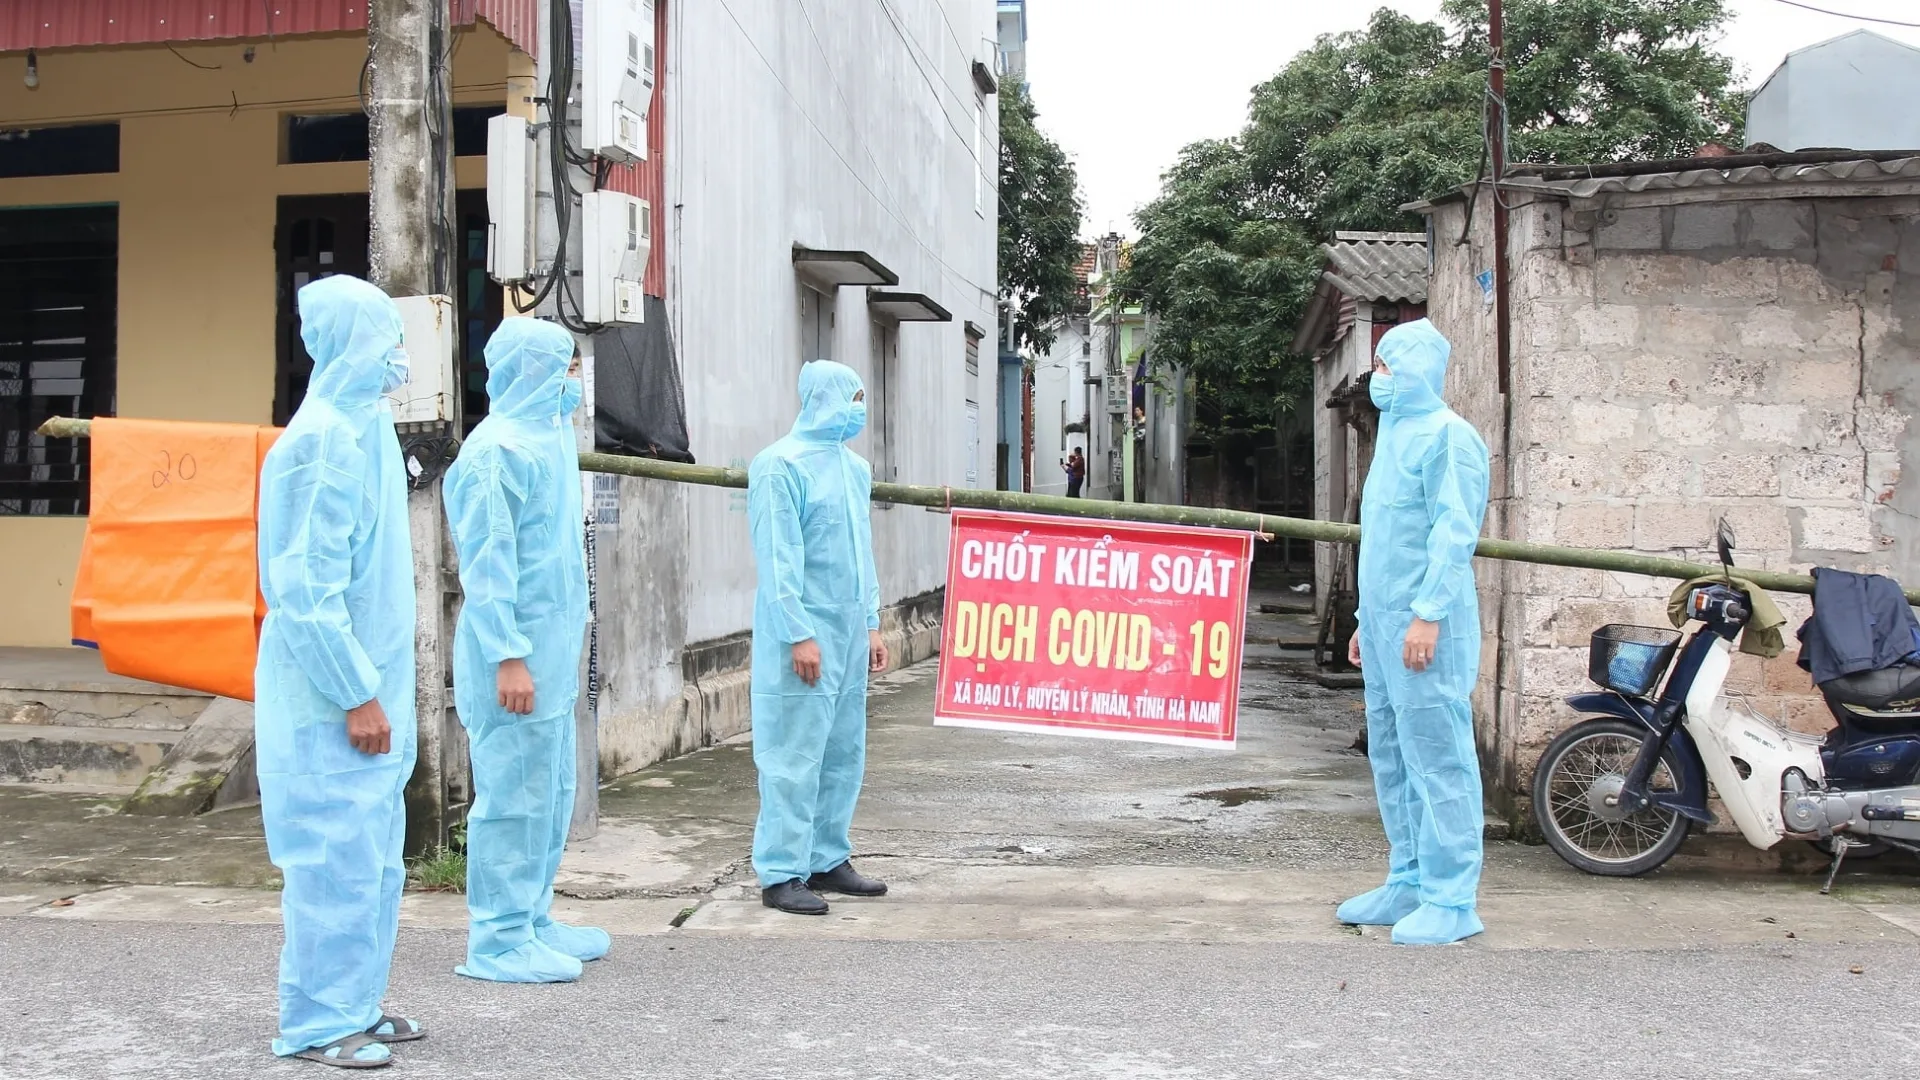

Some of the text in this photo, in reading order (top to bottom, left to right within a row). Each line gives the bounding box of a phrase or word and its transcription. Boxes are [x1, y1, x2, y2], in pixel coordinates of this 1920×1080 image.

[152, 449, 197, 489] 20
[961, 530, 1236, 598] CHỐT KIỂM SOÁT
[953, 600, 1231, 679] DỊCH COVID - 19
[953, 678, 1221, 725] XÃ ĐẠO LÝ, HUYỆN LÝ NHÂN, TỈNH HÀ NAM
